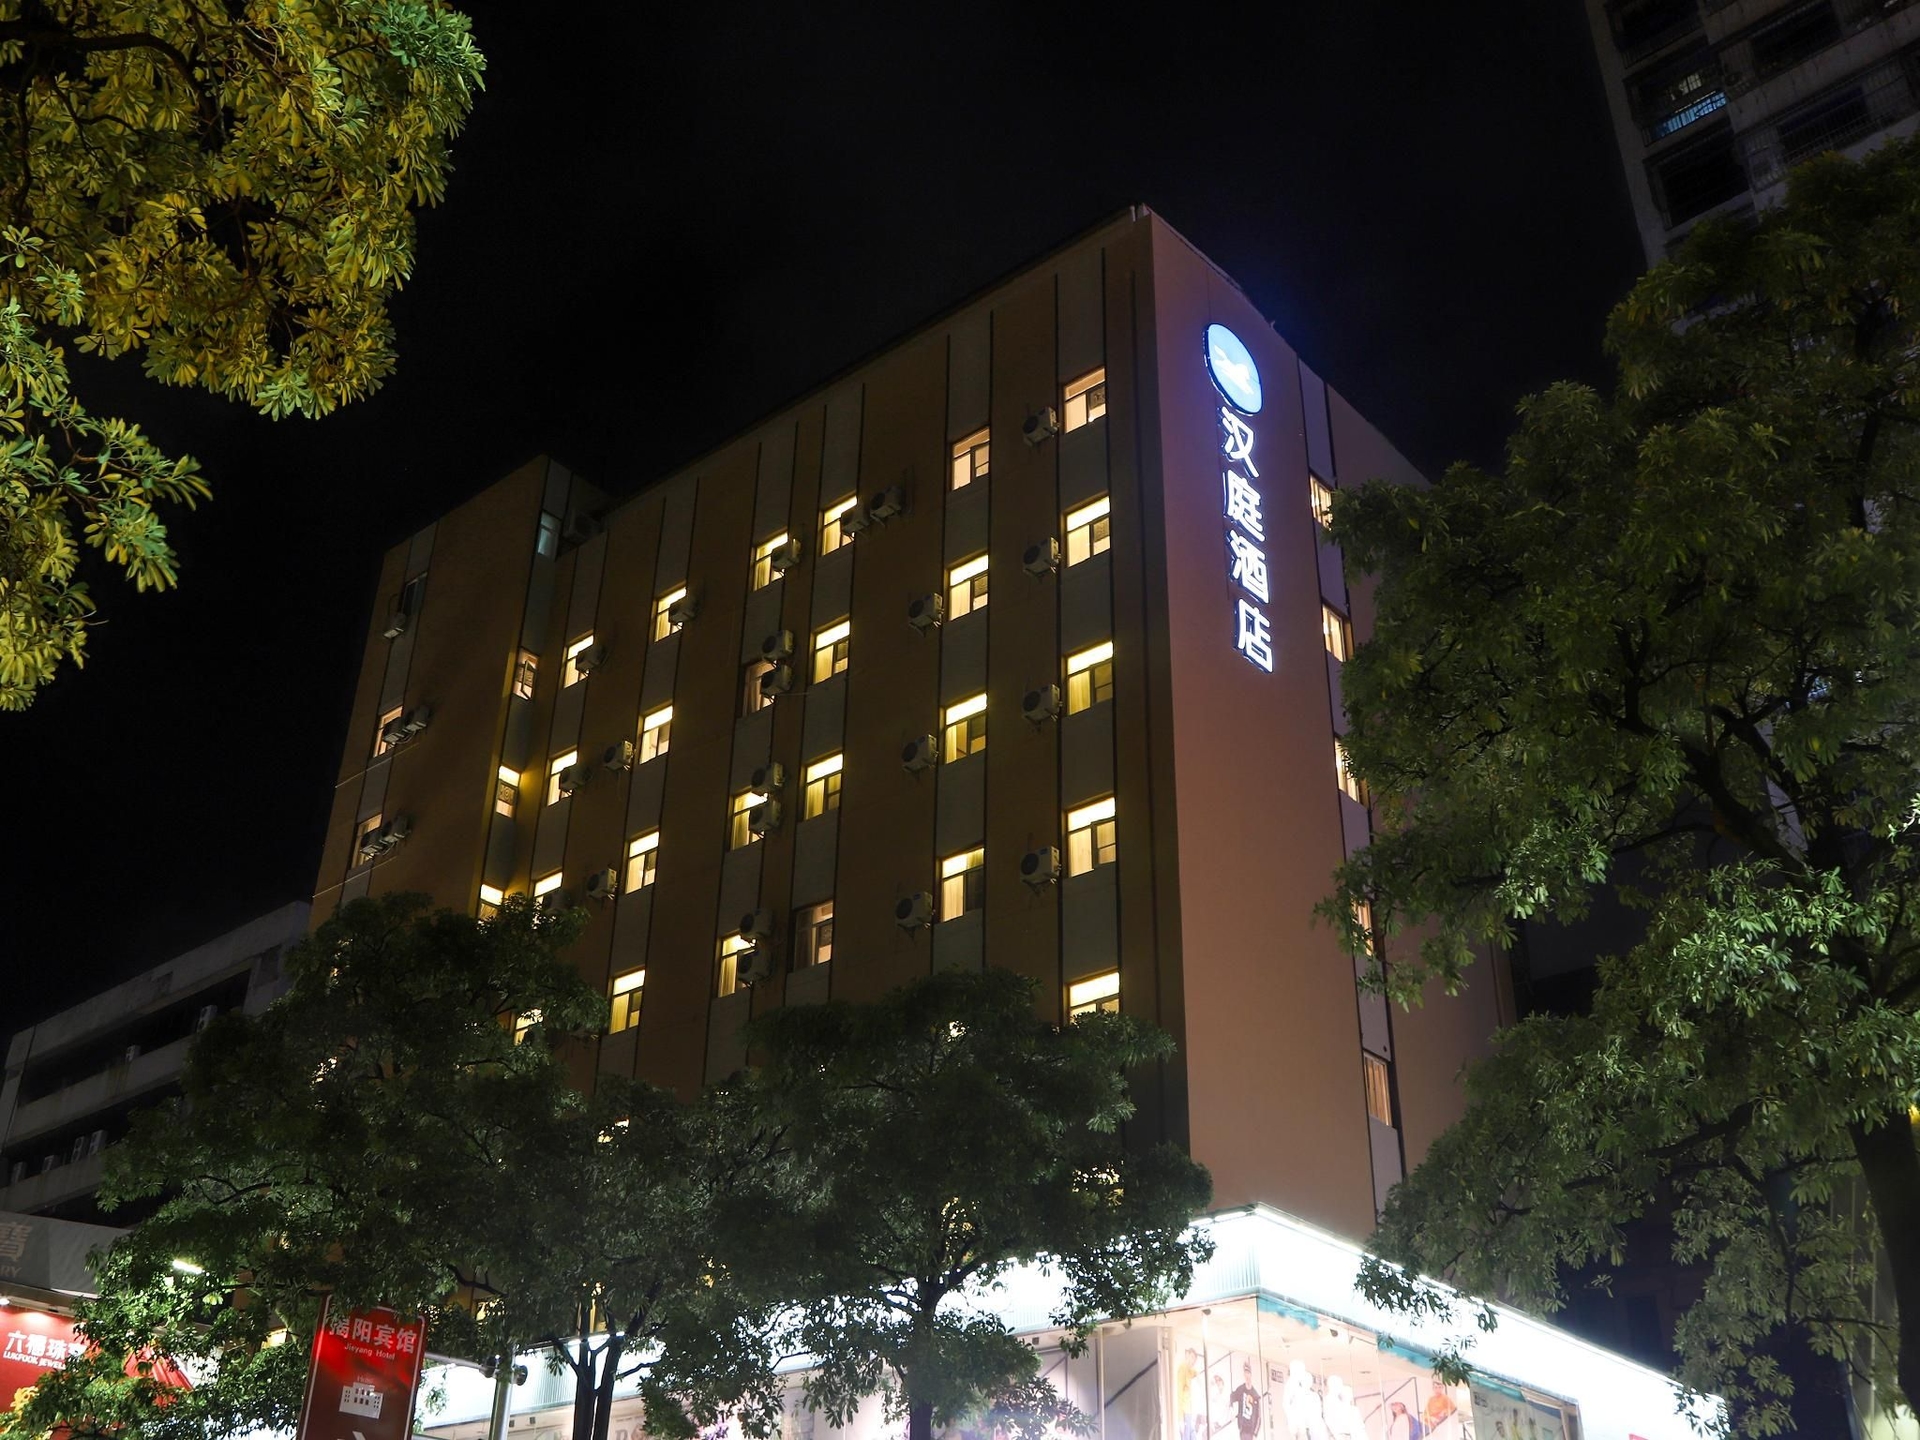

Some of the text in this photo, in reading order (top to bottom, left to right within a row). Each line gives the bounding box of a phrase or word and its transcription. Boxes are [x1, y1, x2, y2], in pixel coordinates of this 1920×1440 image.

[1218, 406, 1274, 673] 汉庭酒店
[329, 1317, 417, 1354] 揭阳宾馆
[376, 1350, 395, 1360] Hotel
